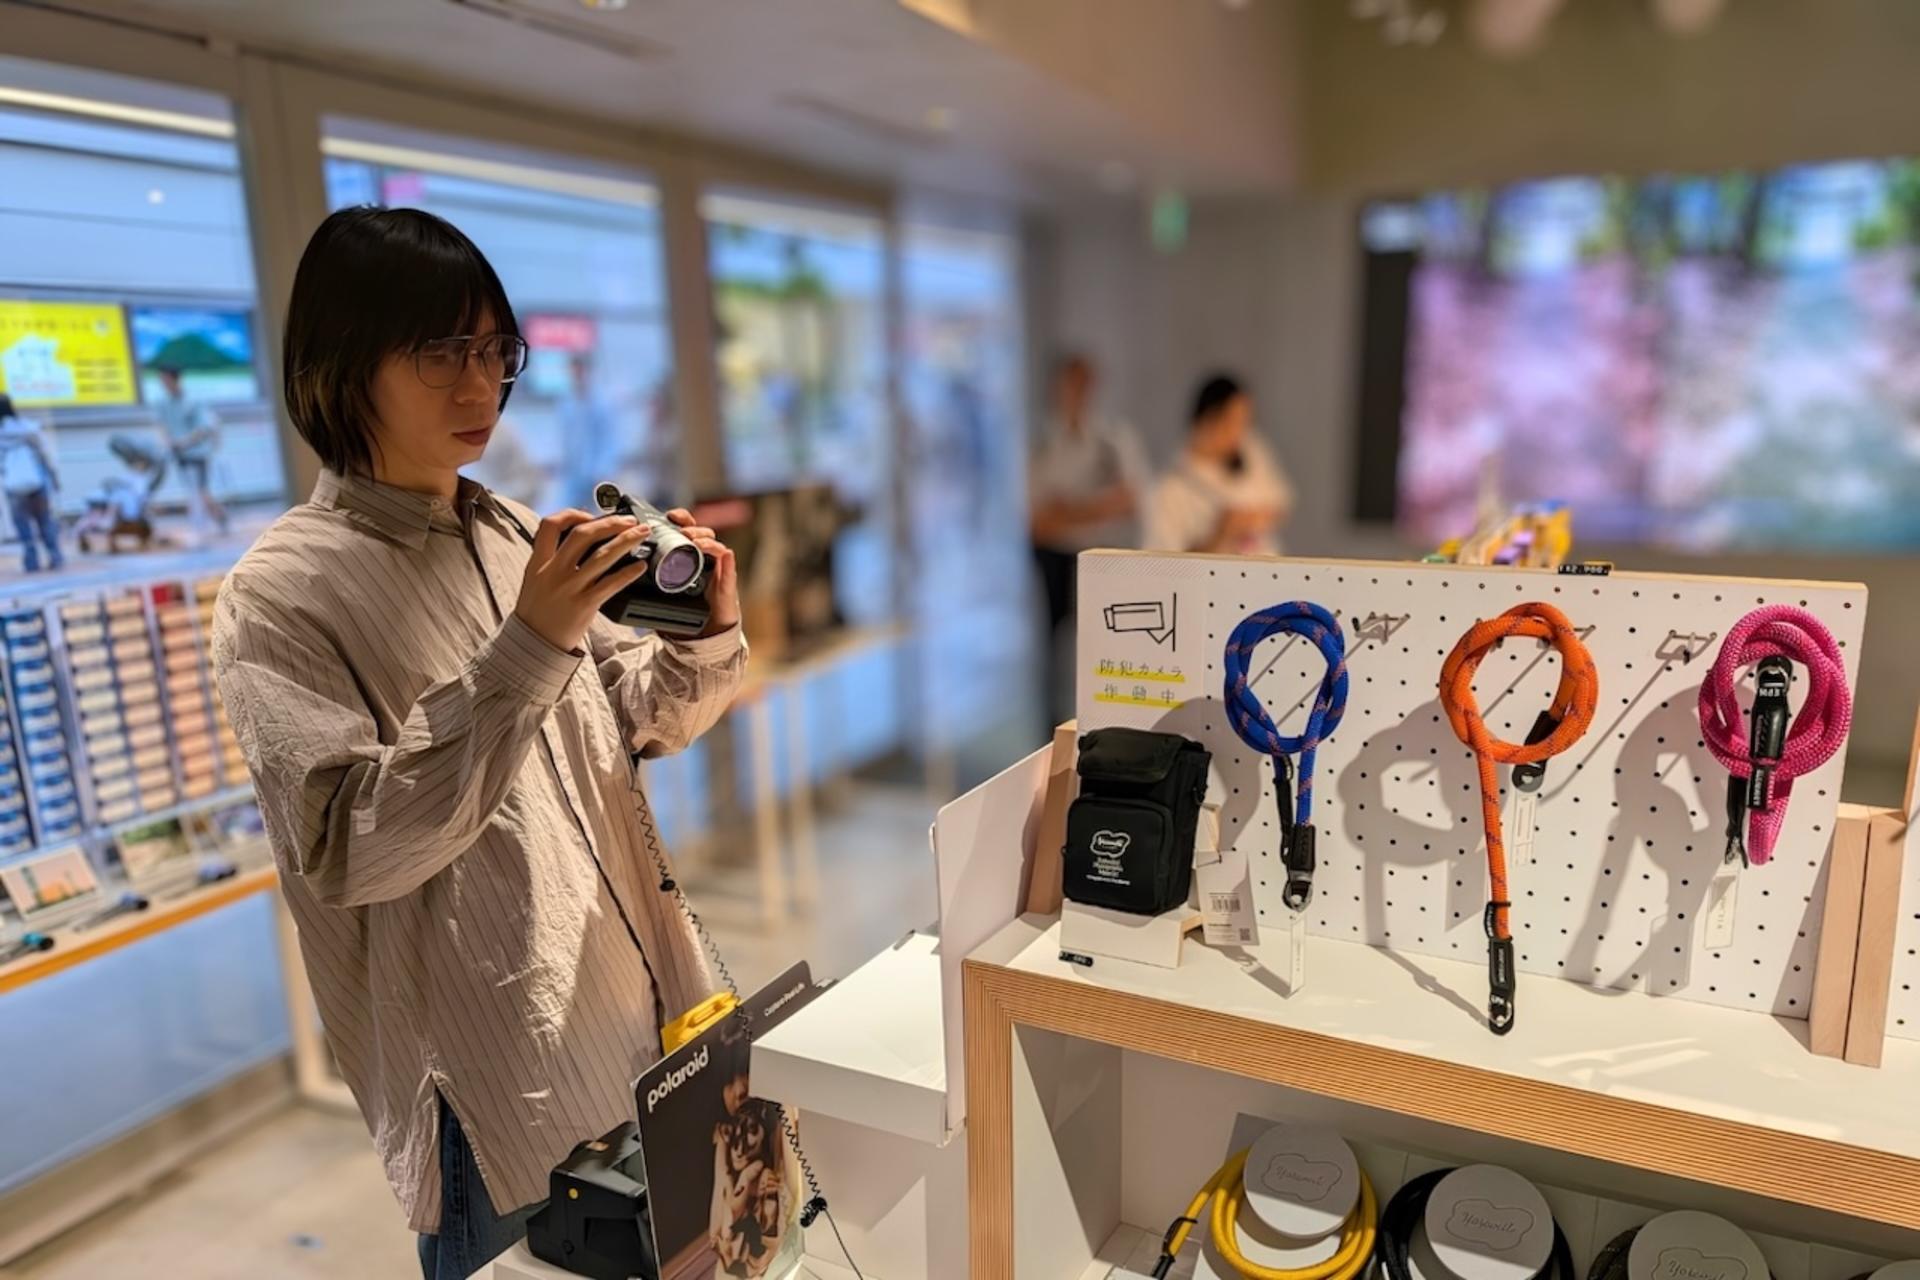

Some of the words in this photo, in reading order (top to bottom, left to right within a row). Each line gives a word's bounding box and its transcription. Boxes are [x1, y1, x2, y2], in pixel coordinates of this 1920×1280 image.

[1099, 658, 1182, 677] 防犯カメラ
[647, 1044, 709, 1113] polaroid
